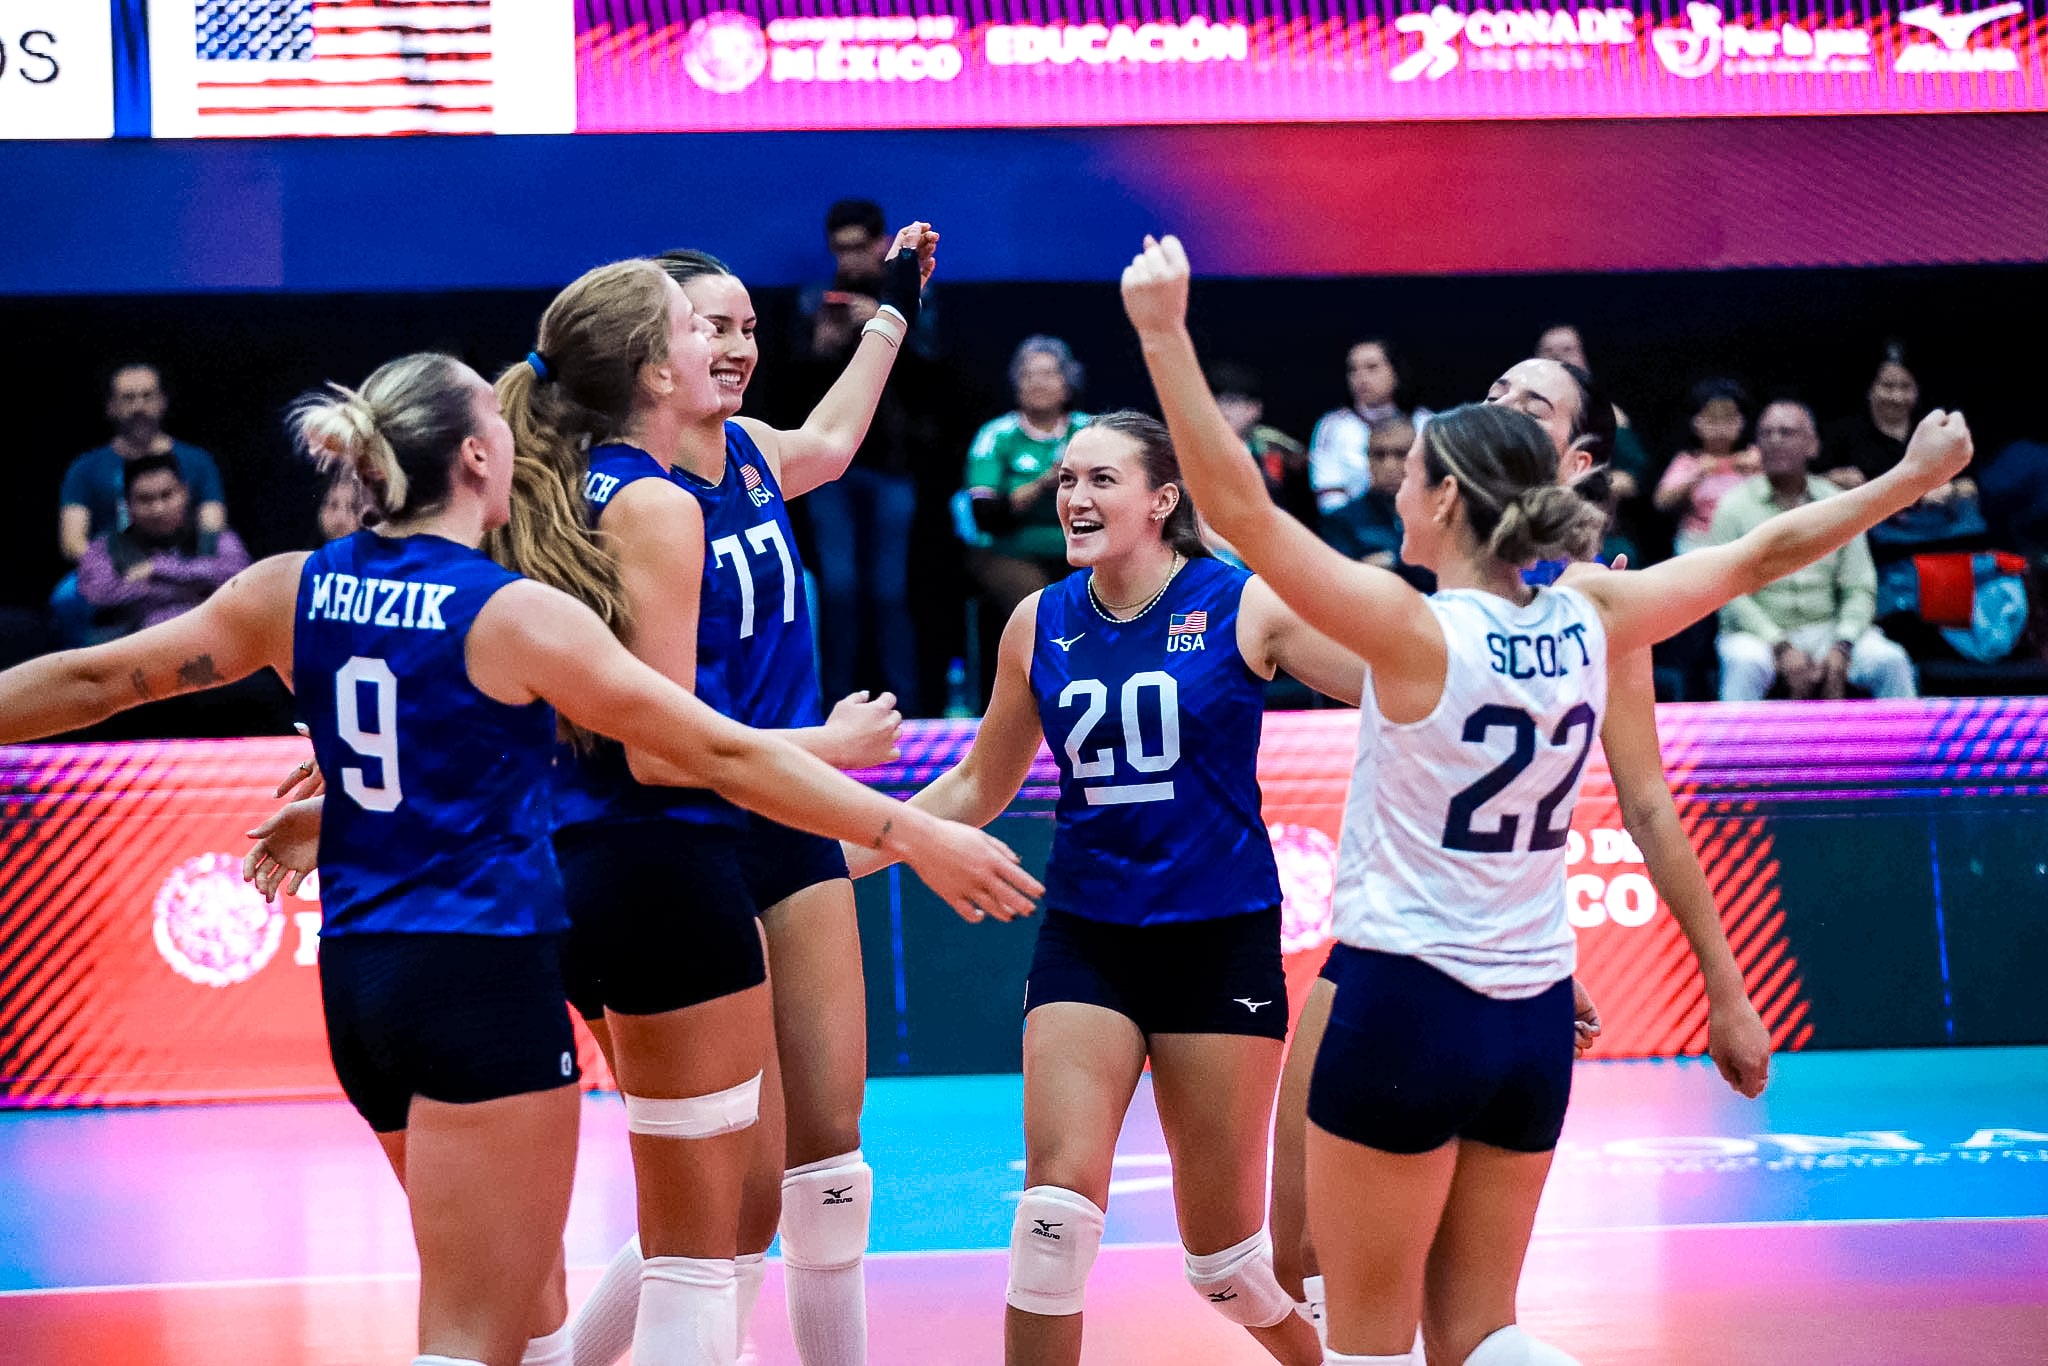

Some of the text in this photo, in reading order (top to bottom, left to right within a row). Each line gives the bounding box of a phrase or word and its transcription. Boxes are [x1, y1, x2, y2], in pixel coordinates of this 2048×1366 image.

[771, 38, 962, 82] MÉXICO
[985, 16, 1248, 65] EDUCACIÓN
[583, 471, 620, 503] CH
[747, 482, 775, 508] USA
[308, 572, 457, 630] MRUZIK
[711, 519, 796, 639] 77
[1166, 634, 1206, 653] USA
[1487, 623, 1590, 679] SCOT
[336, 655, 404, 813] 9
[1058, 670, 1181, 779] 20
[1442, 702, 1596, 853] 22
